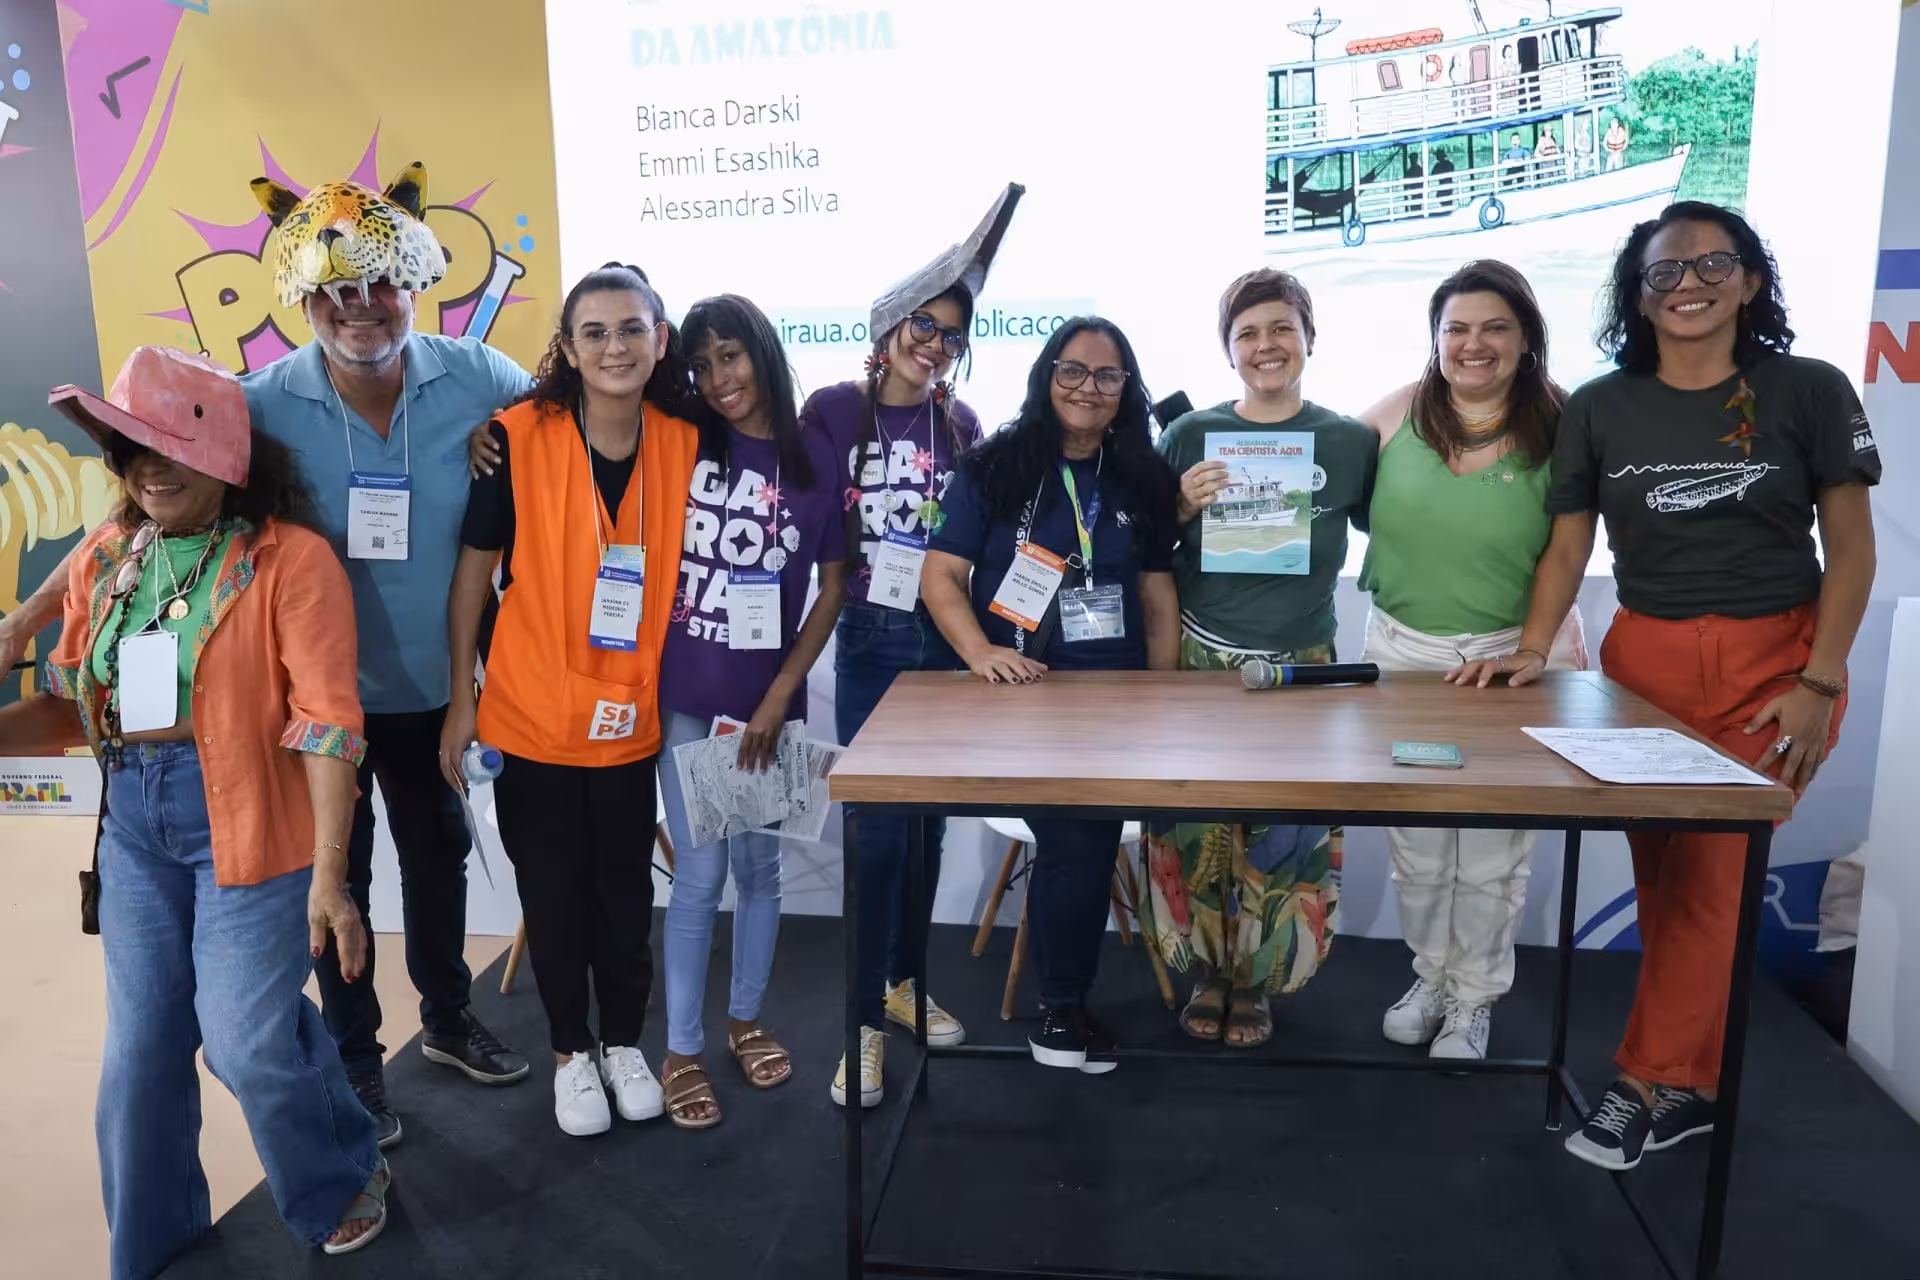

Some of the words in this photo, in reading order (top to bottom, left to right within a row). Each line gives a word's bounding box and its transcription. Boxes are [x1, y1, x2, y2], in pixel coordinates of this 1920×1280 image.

[630, 27, 682, 69] DA
[690, 3, 896, 65] AMAZÔNIA
[636, 104, 715, 132] Bianca
[725, 94, 801, 126] Darski
[639, 147, 704, 178] Emmi
[715, 141, 819, 173] Esashika
[640, 189, 775, 222] Alessandra
[782, 186, 839, 214] Silva
[781, 318, 868, 345] iraua.o
[974, 308, 1065, 338] blicaco
[1218, 446, 1236, 456] TEM
[1237, 446, 1278, 456] CIENTISTA
[1853, 433, 1875, 451] BRA
[689, 459, 770, 517] GA
[683, 506, 764, 566] RO
[687, 615, 729, 643] STE
